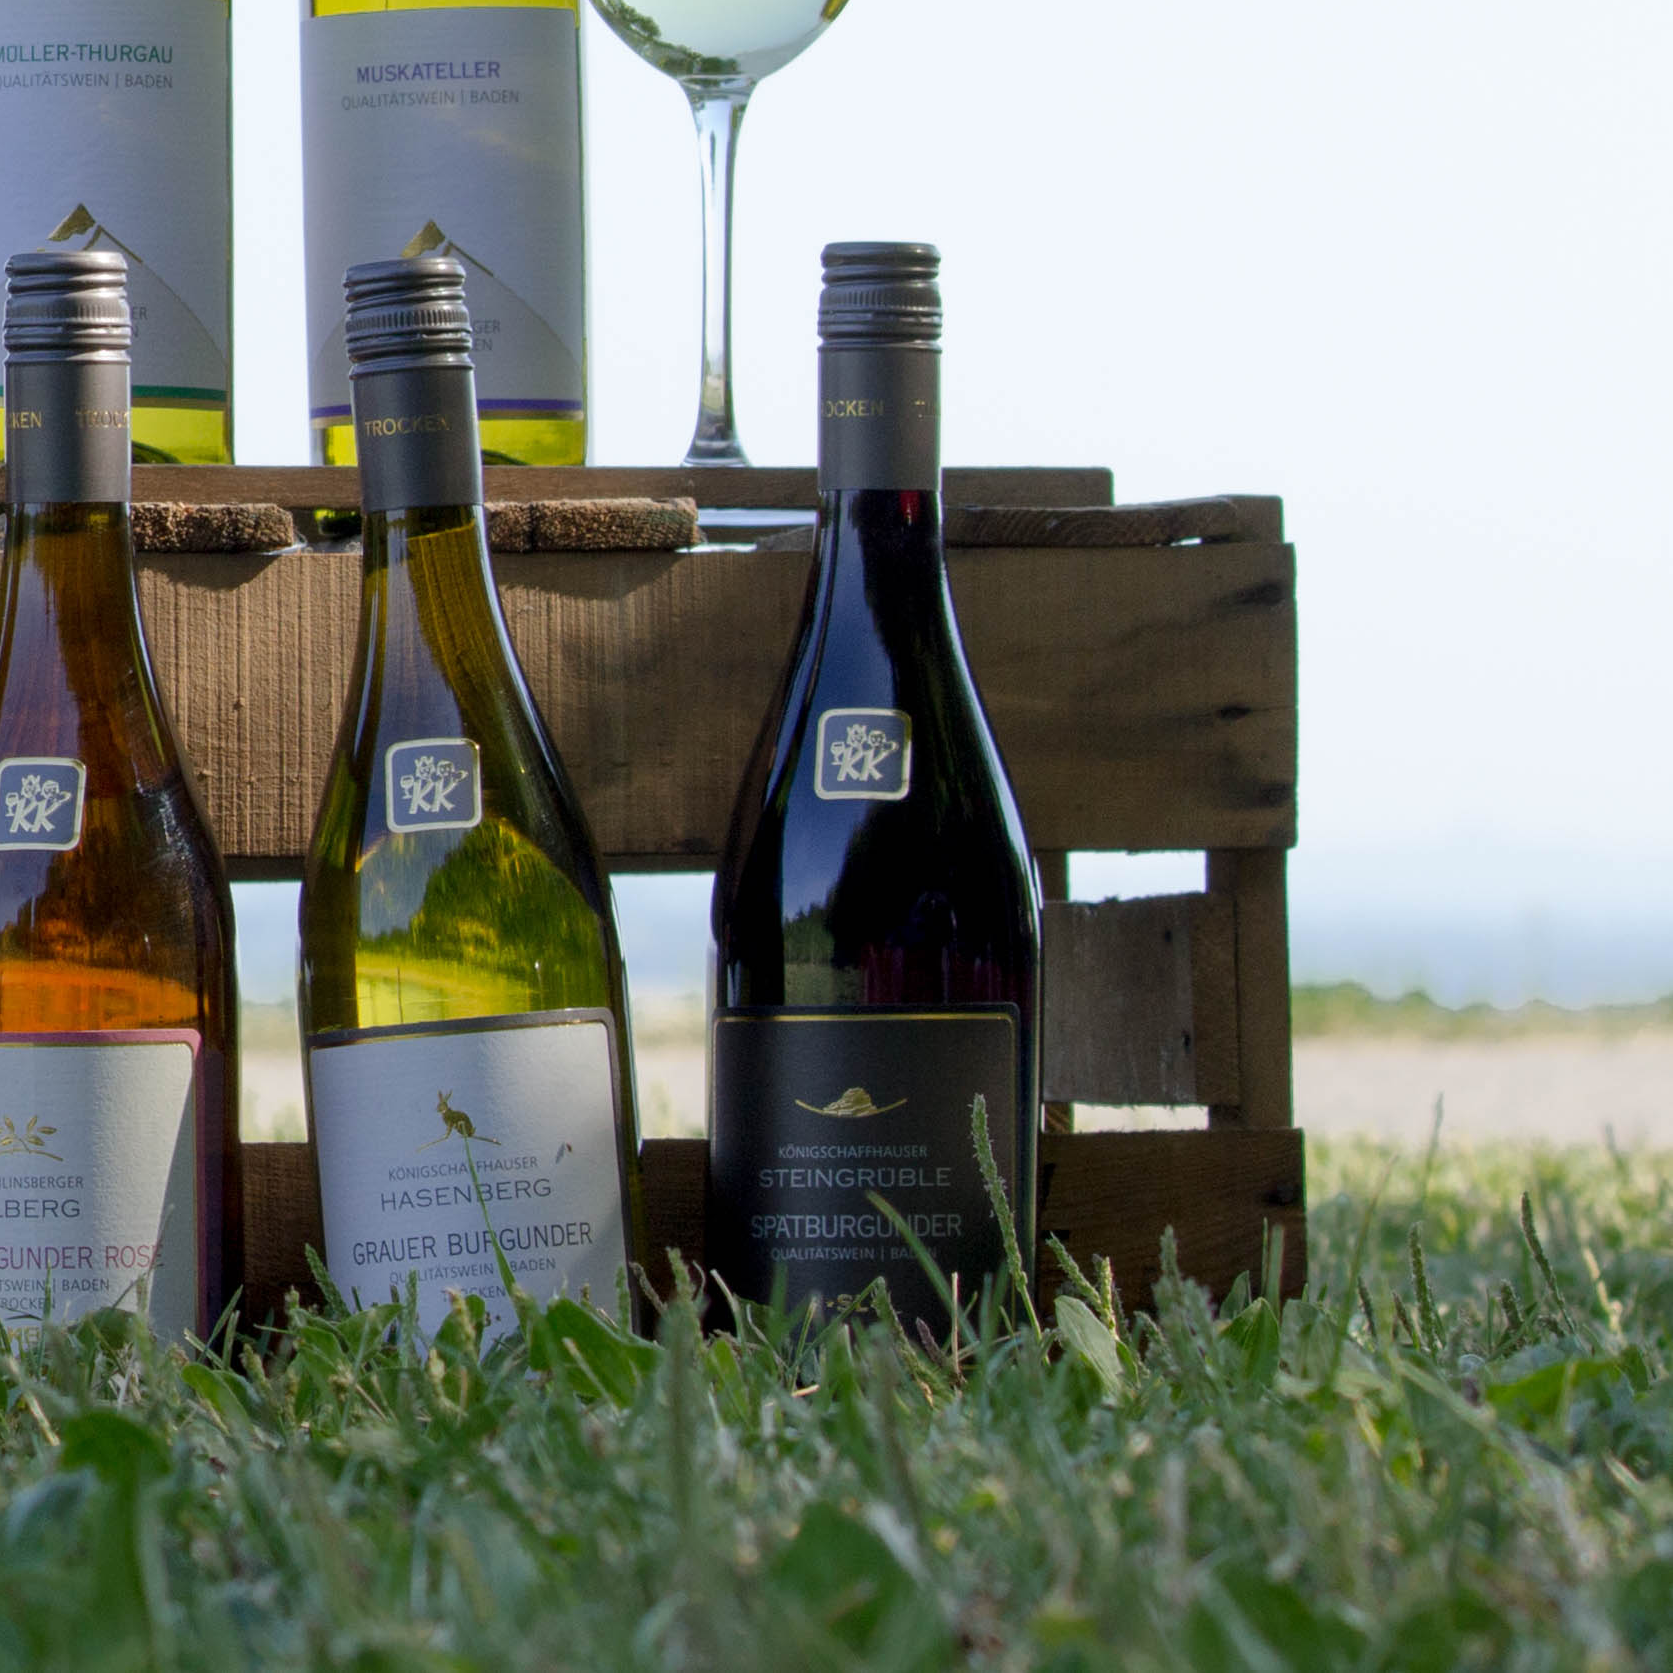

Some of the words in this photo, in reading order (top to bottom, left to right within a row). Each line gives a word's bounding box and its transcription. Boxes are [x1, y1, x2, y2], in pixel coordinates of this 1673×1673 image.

[124, 74, 173, 89] BADEN
[356, 61, 501, 84] MUSKATELLER
[341, 89, 455, 111] QUALITÄTSWEIN
[469, 89, 520, 105] BADEN
[364, 413, 452, 437] TROCKEN
[778, 1143, 928, 1160] KÖNIGSCHAFFHAUSER
[388, 1155, 539, 1181] KÖNIGSCHAFHAUSER
[759, 1167, 952, 1189] STEINGRÜBLE
[380, 1177, 552, 1212] HASENBERG
[352, 1234, 438, 1266] GRAUER
[447, 1221, 594, 1257] BURGUNDER
[770, 1245, 875, 1263] QUALITÄTSWEIN
[889, 1246, 937, 1261] BAN
[389, 1262, 495, 1286] QULITÄTSWEIN
[510, 1257, 557, 1273] BADEN
[61, 1278, 110, 1292] BADEN
